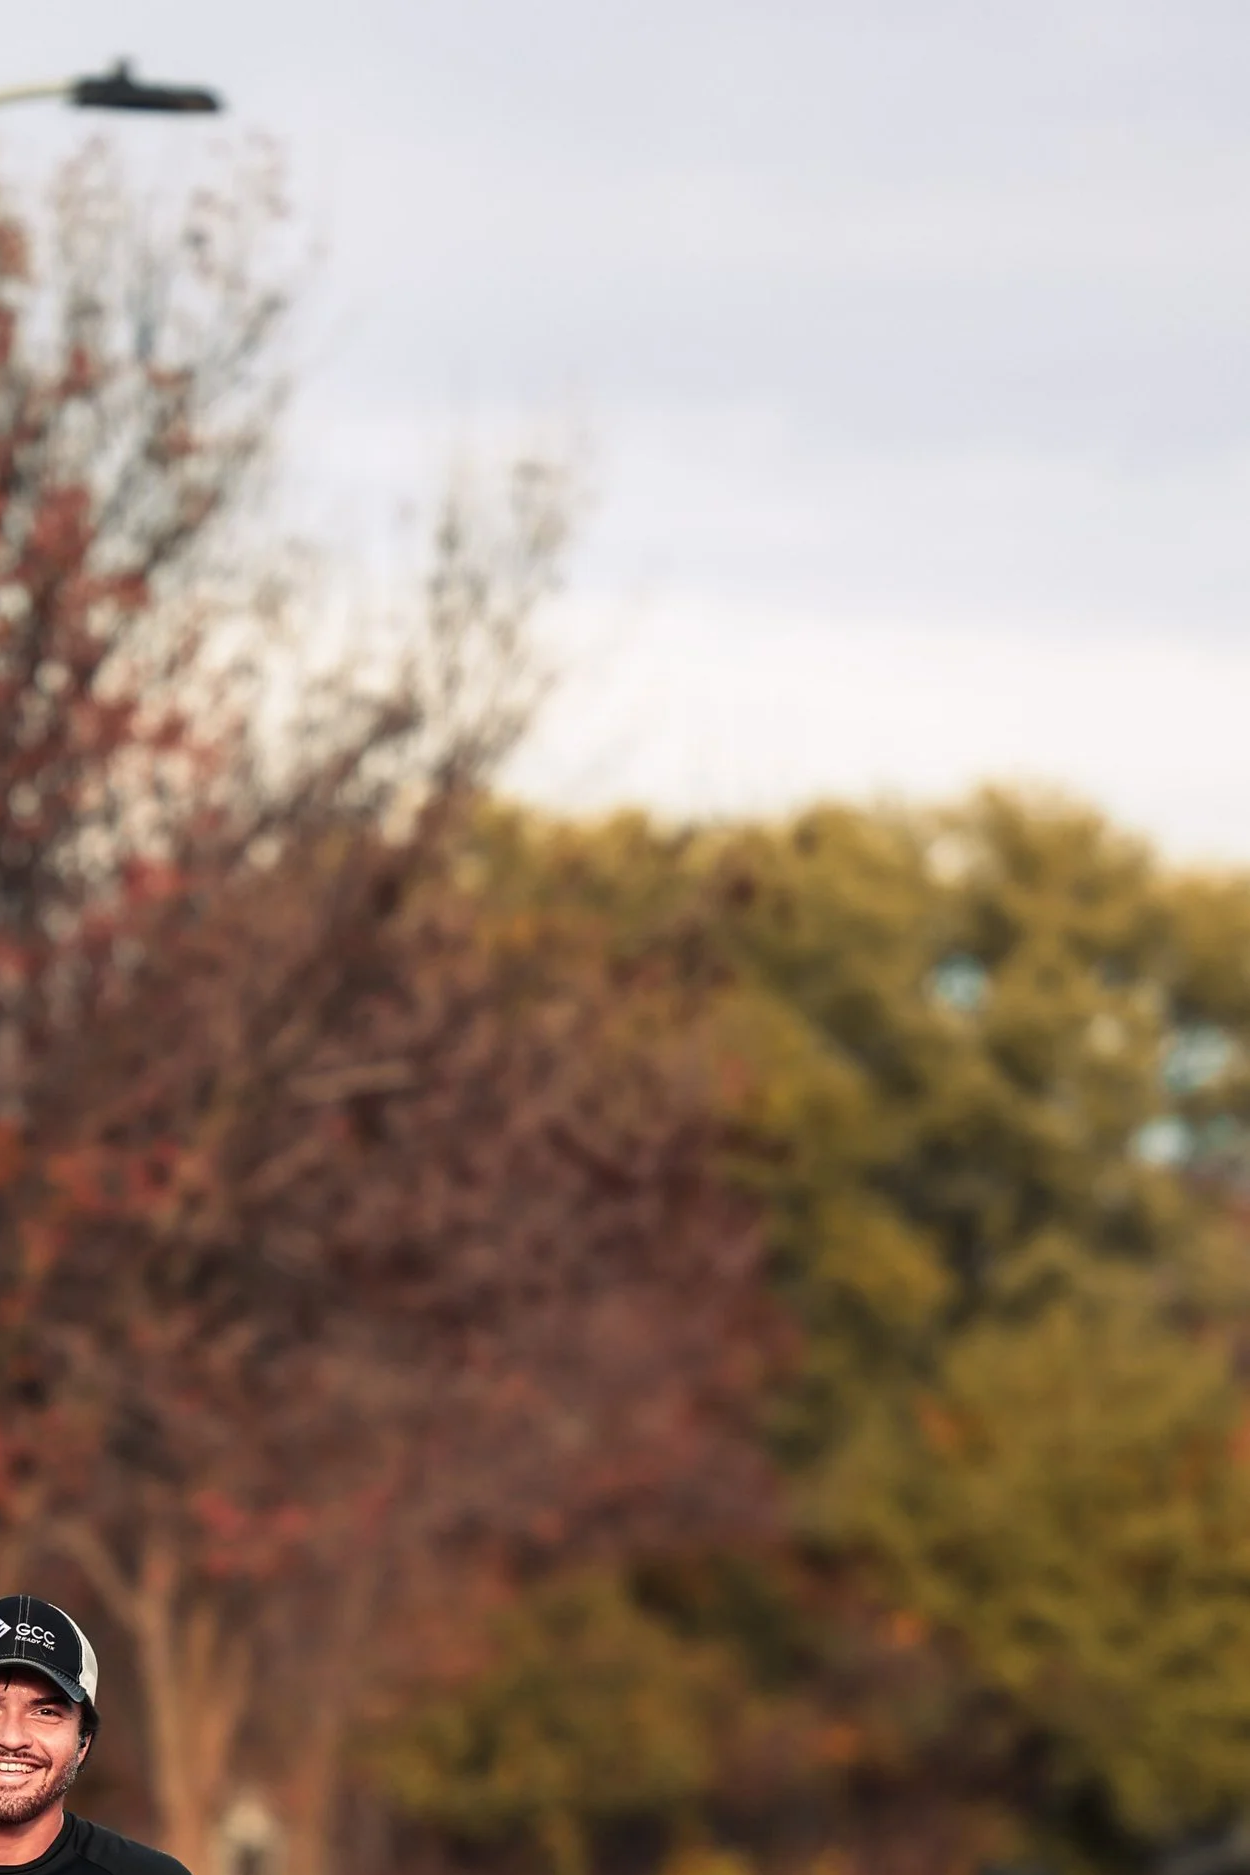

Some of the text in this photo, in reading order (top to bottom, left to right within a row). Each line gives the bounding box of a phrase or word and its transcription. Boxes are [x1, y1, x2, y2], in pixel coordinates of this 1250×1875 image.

[14, 1635, 55, 1651] READY MIX
[15, 1622, 55, 1645] GCC
